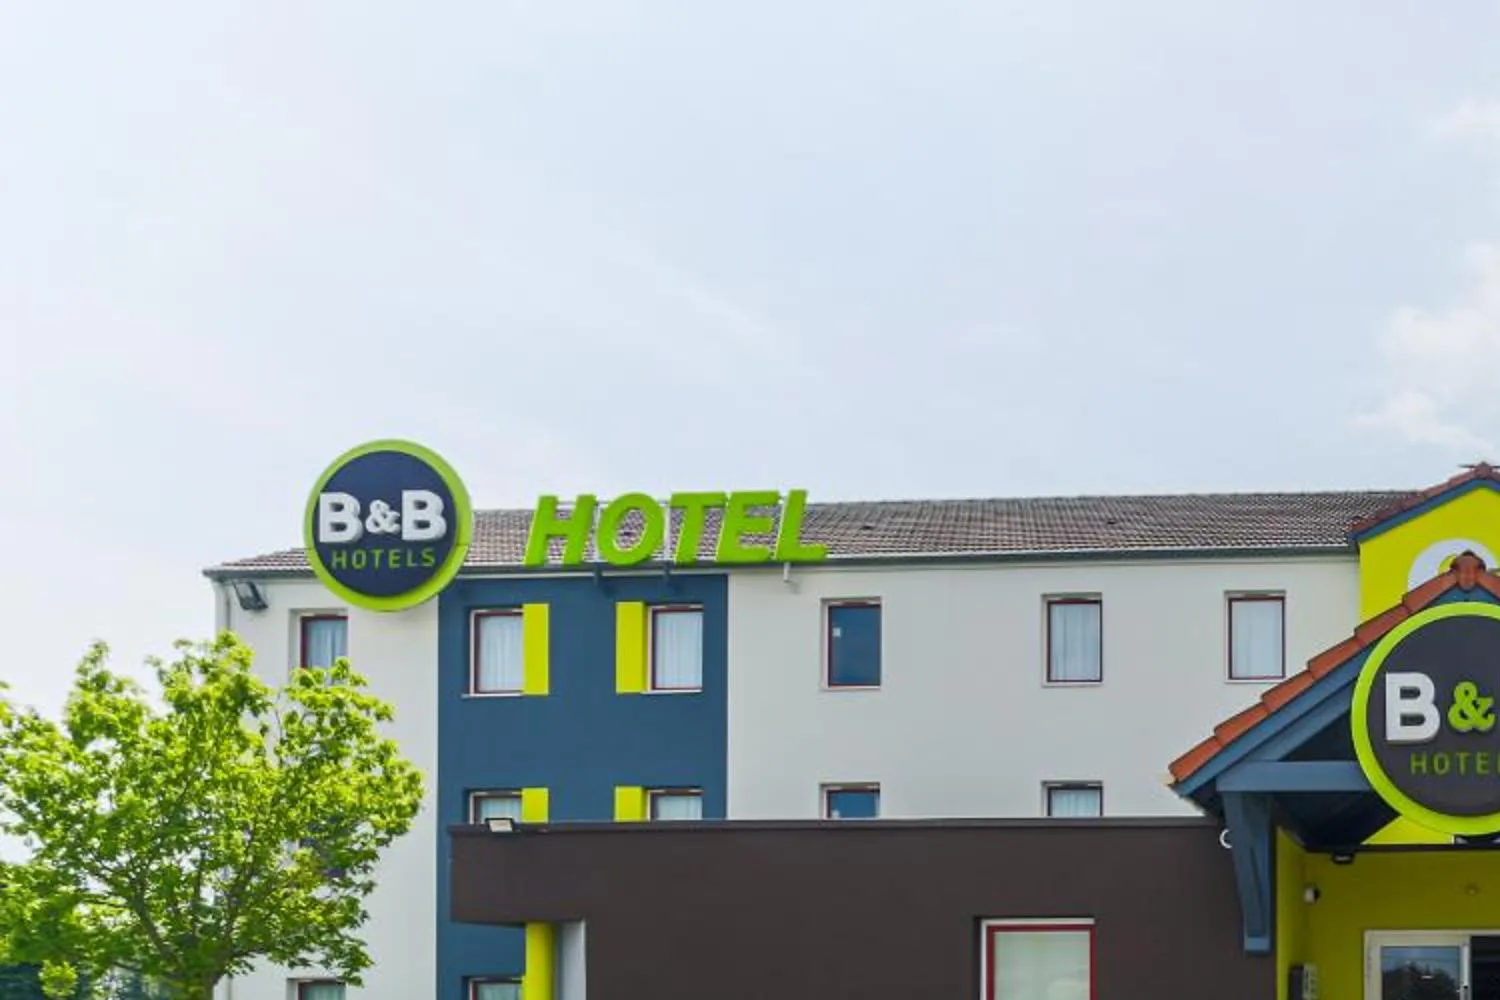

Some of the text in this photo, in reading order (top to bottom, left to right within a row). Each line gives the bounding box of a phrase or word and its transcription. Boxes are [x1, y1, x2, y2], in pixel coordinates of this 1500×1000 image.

[318, 489, 447, 544] B&B
[523, 489, 828, 567] HOTEL
[330, 547, 437, 570] HOTELS
